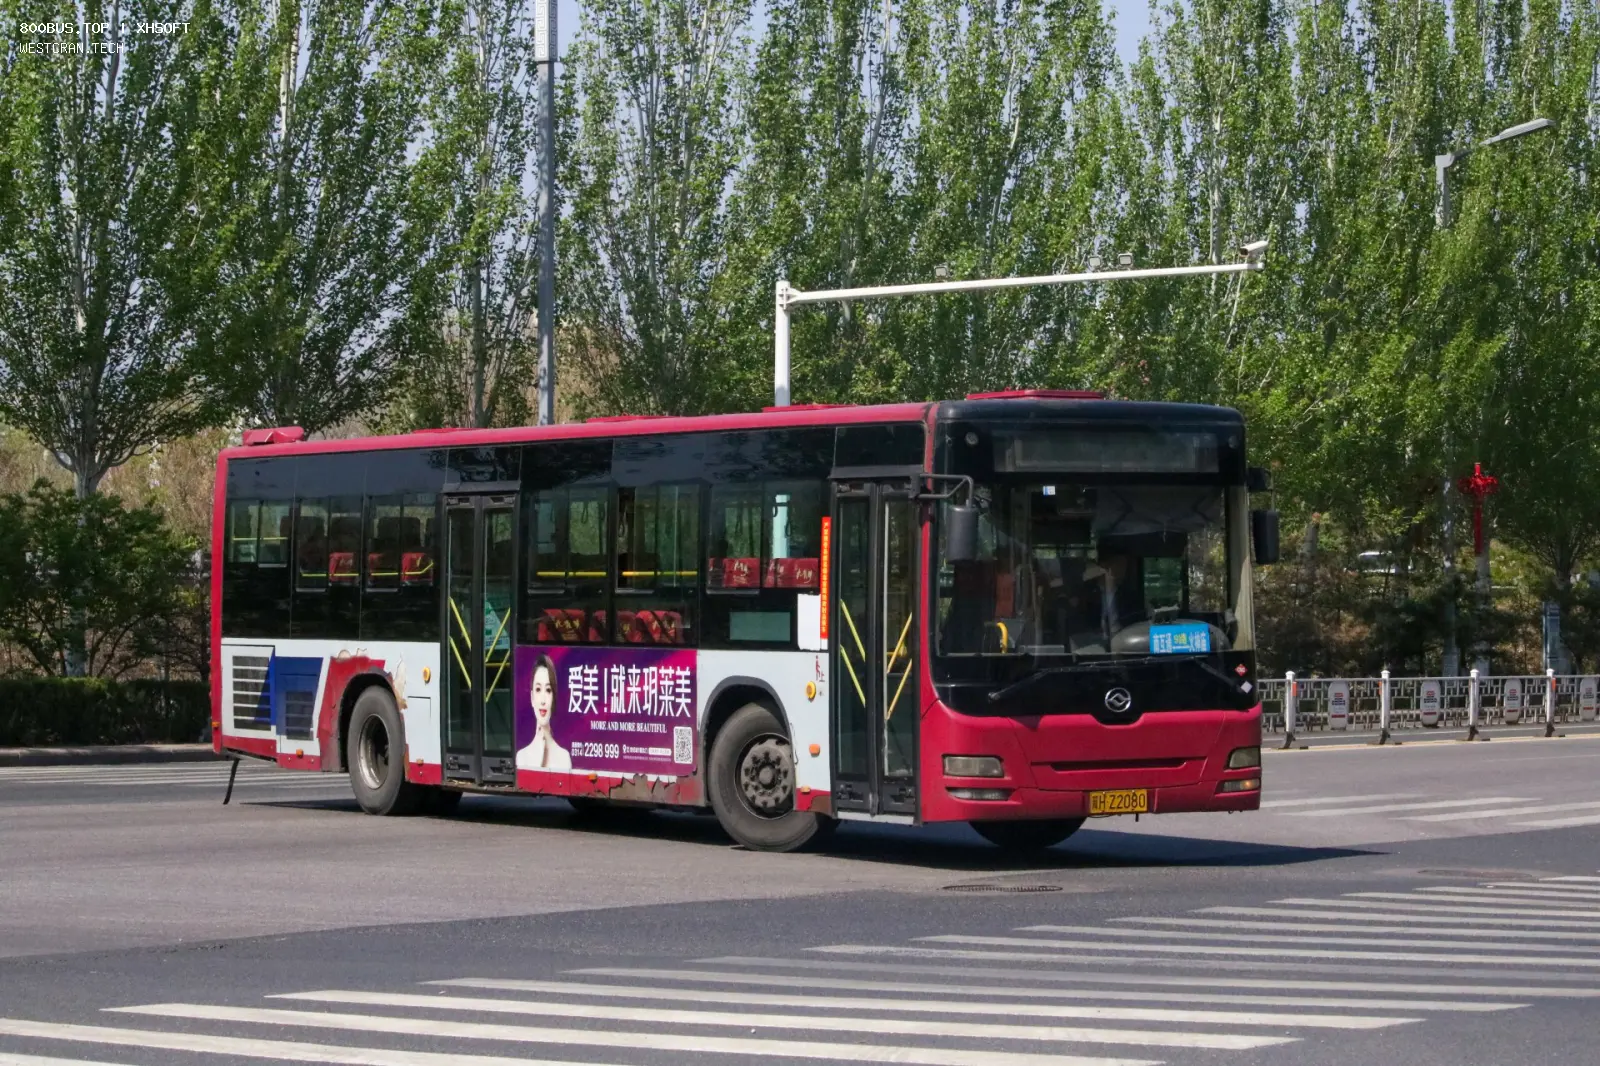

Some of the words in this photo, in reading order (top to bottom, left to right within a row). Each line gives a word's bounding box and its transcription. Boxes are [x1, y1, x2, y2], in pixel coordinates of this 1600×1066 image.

[590, 720, 606, 730] MORE
[607, 721, 619, 731] AND
[619, 721, 636, 732] MORE
[636, 722, 668, 734] BEAUTIFUL
[584, 742, 603, 758] 2298
[604, 743, 620, 759] 999
